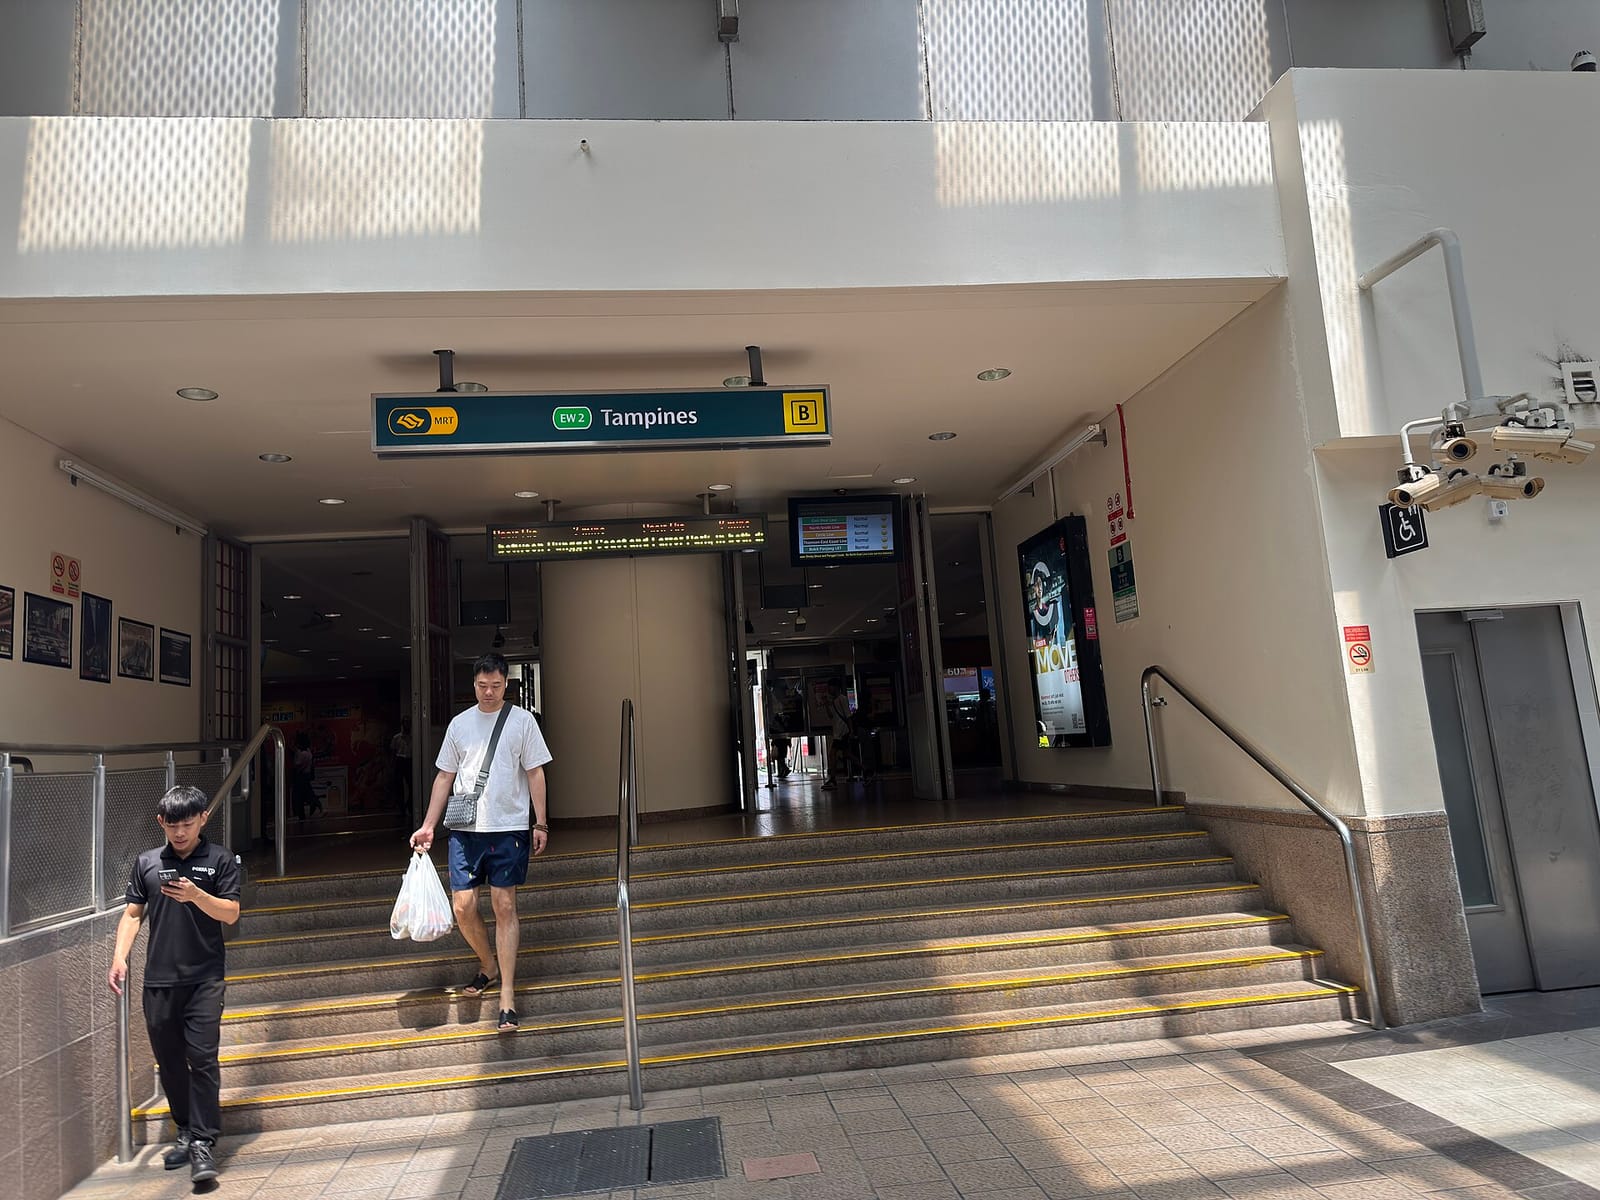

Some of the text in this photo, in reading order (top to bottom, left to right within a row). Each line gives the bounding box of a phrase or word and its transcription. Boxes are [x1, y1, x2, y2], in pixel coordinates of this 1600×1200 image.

[434, 416, 454, 425] MRT
[560, 412, 585, 423] EW 2
[600, 407, 698, 429] Tampines
[799, 405, 810, 421] B
[1035, 639, 1078, 674] MOVE
